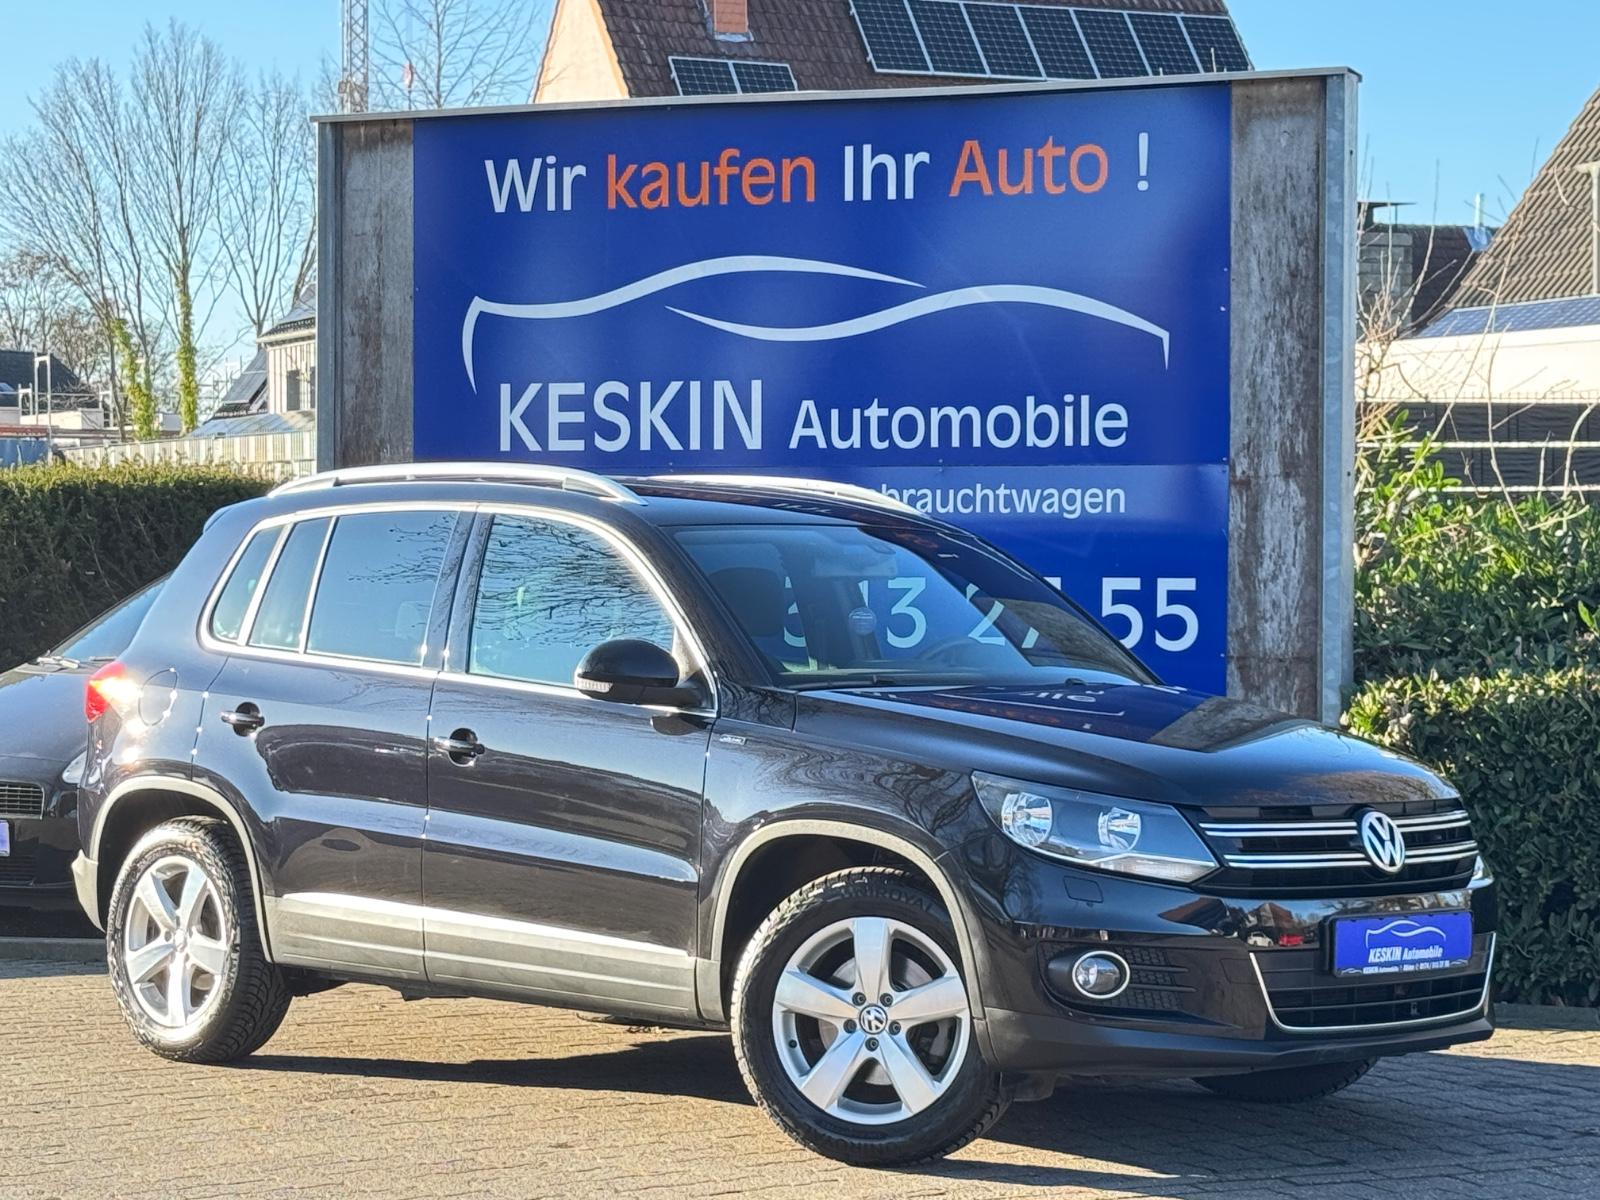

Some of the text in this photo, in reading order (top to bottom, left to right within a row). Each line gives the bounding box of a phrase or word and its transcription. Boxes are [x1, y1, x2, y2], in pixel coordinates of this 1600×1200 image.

[484, 131, 1149, 213] Wir kaufen Ihr Auto !
[499, 379, 1129, 453] KESKIN Automobile
[1101, 577, 1199, 652] 55
[1368, 945, 1443, 963] KESKIN Automobile
